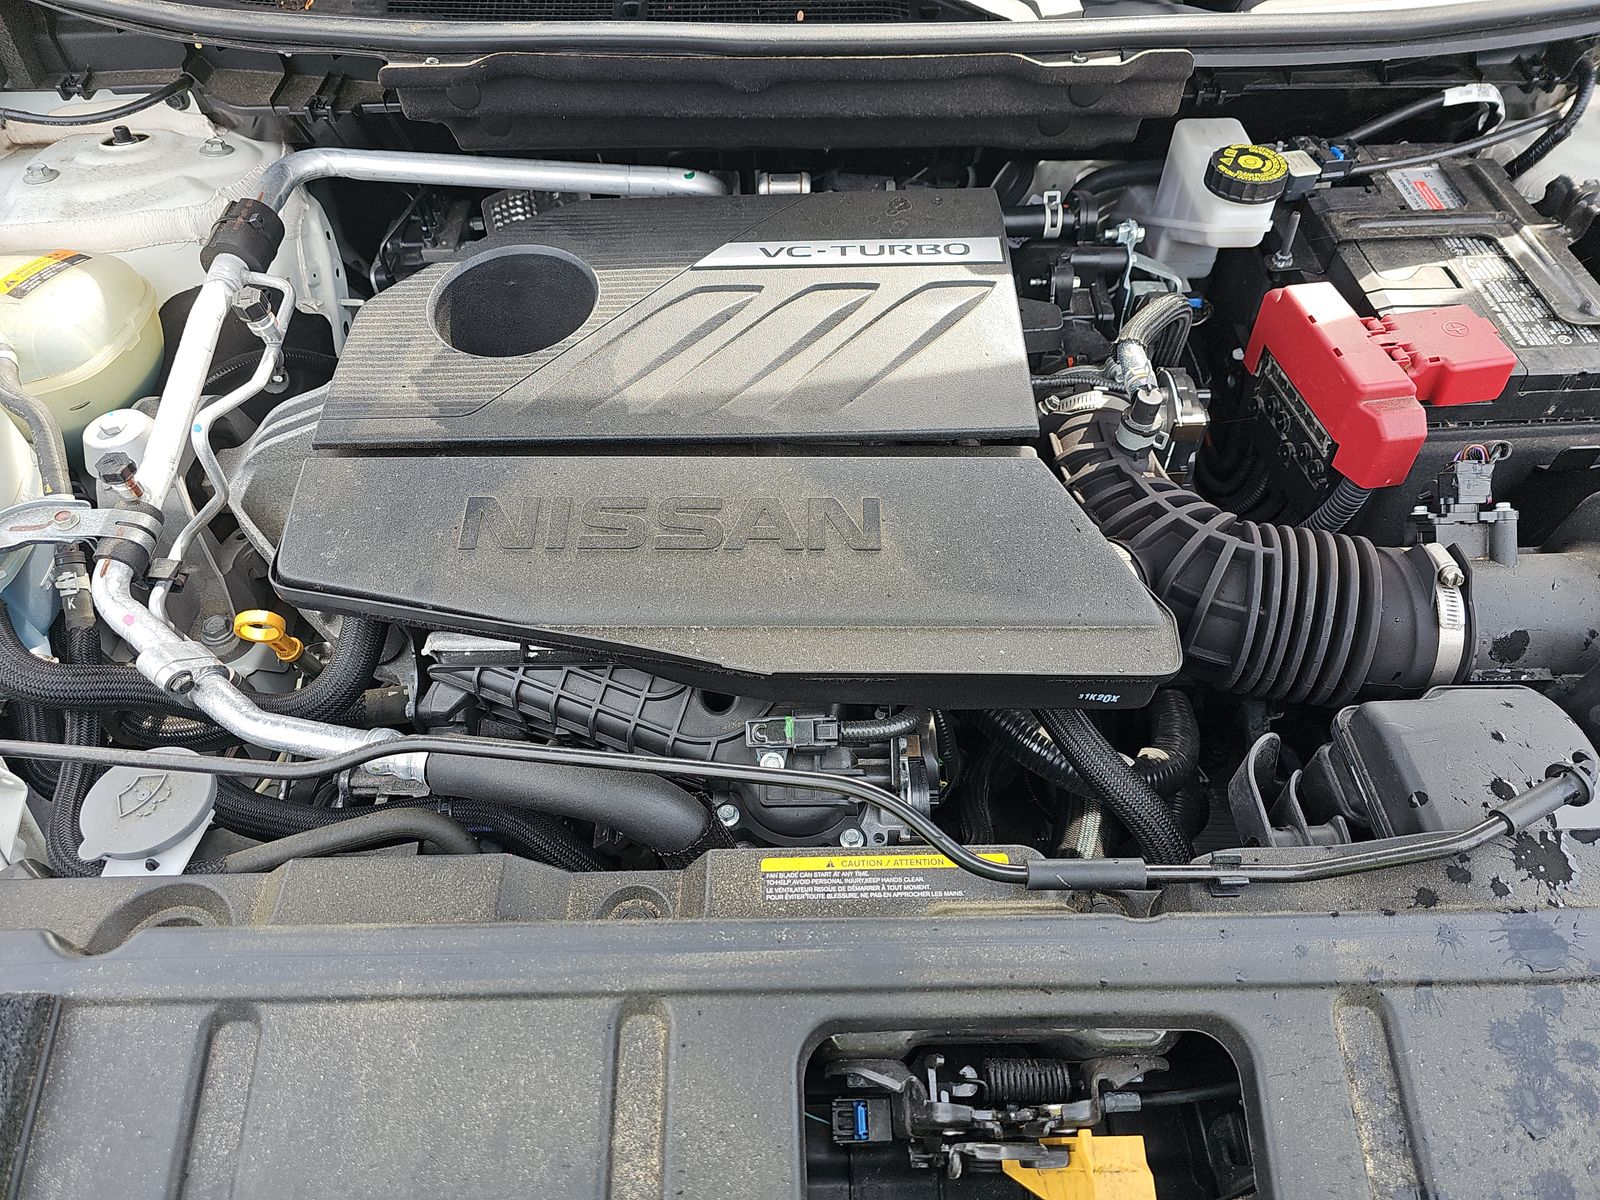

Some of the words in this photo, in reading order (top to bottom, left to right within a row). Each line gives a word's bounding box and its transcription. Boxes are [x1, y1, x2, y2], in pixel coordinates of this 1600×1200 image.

[758, 242, 970, 258] VC-TURBO
[457, 496, 882, 551] NISSAN
[67, 597, 76, 610] K
[841, 860, 883, 868] CAUTION
[886, 859, 890, 867] /
[893, 858, 945, 866] ATTENTION
[780, 871, 798, 879] BLADE
[847, 884, 880, 892] DÉMARRER
[893, 890, 930, 898] APPROCHER
